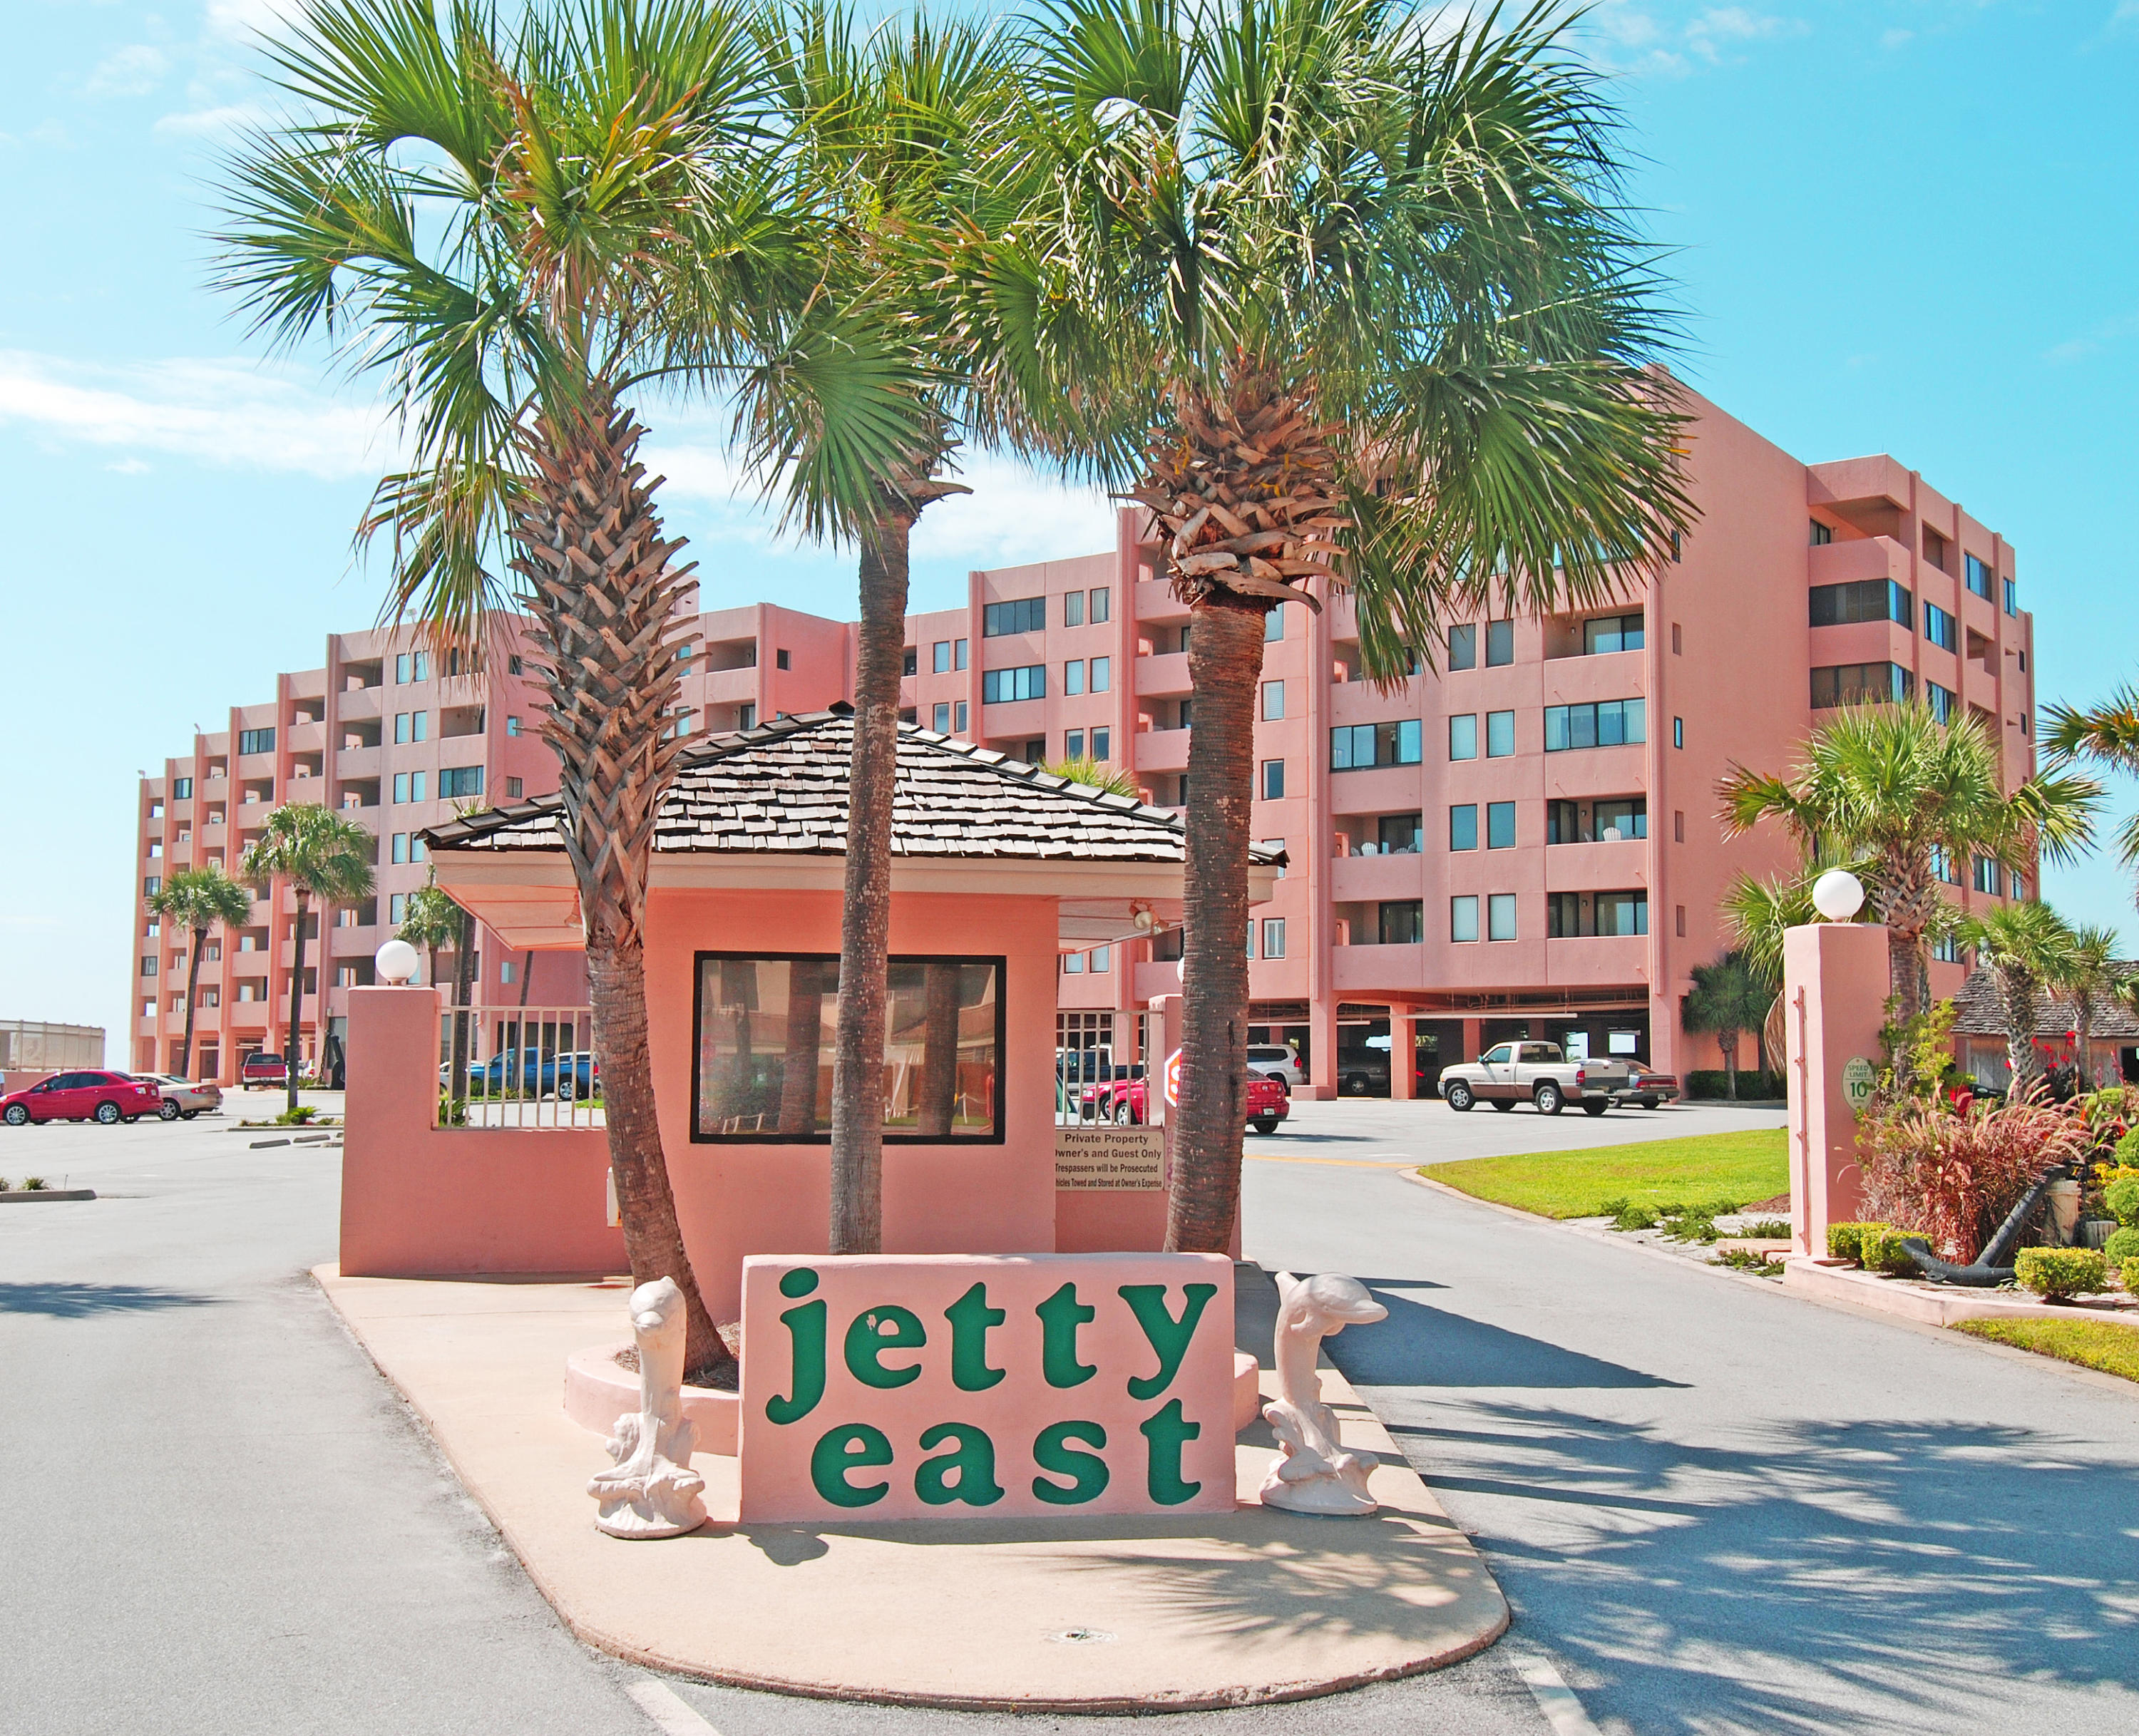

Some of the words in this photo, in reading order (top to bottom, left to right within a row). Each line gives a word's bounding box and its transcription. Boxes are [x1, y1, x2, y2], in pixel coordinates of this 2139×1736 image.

[1850, 1081, 1867, 1097] 10
[1065, 1134, 1101, 1143] Private
[1104, 1134, 1149, 1145] Property
[1092, 1149, 1109, 1158] and
[1112, 1149, 1139, 1158] Guest
[1142, 1149, 1161, 1160] Only
[1055, 1164, 1095, 1173] Trespassers
[1097, 1164, 1108, 1172] will
[1110, 1164, 1119, 1172] be
[1120, 1164, 1158, 1173] Prosecuted
[1072, 1178, 1087, 1187] Towed
[1087, 1178, 1097, 1187] and
[1098, 1178, 1114, 1187] Stored
[1114, 1178, 1120, 1187] at
[1121, 1178, 1141, 1187] Owner's
[1142, 1178, 1162, 1188] Expense
[765, 1267, 1218, 1424] jetty
[811, 1398, 1201, 1508] east
